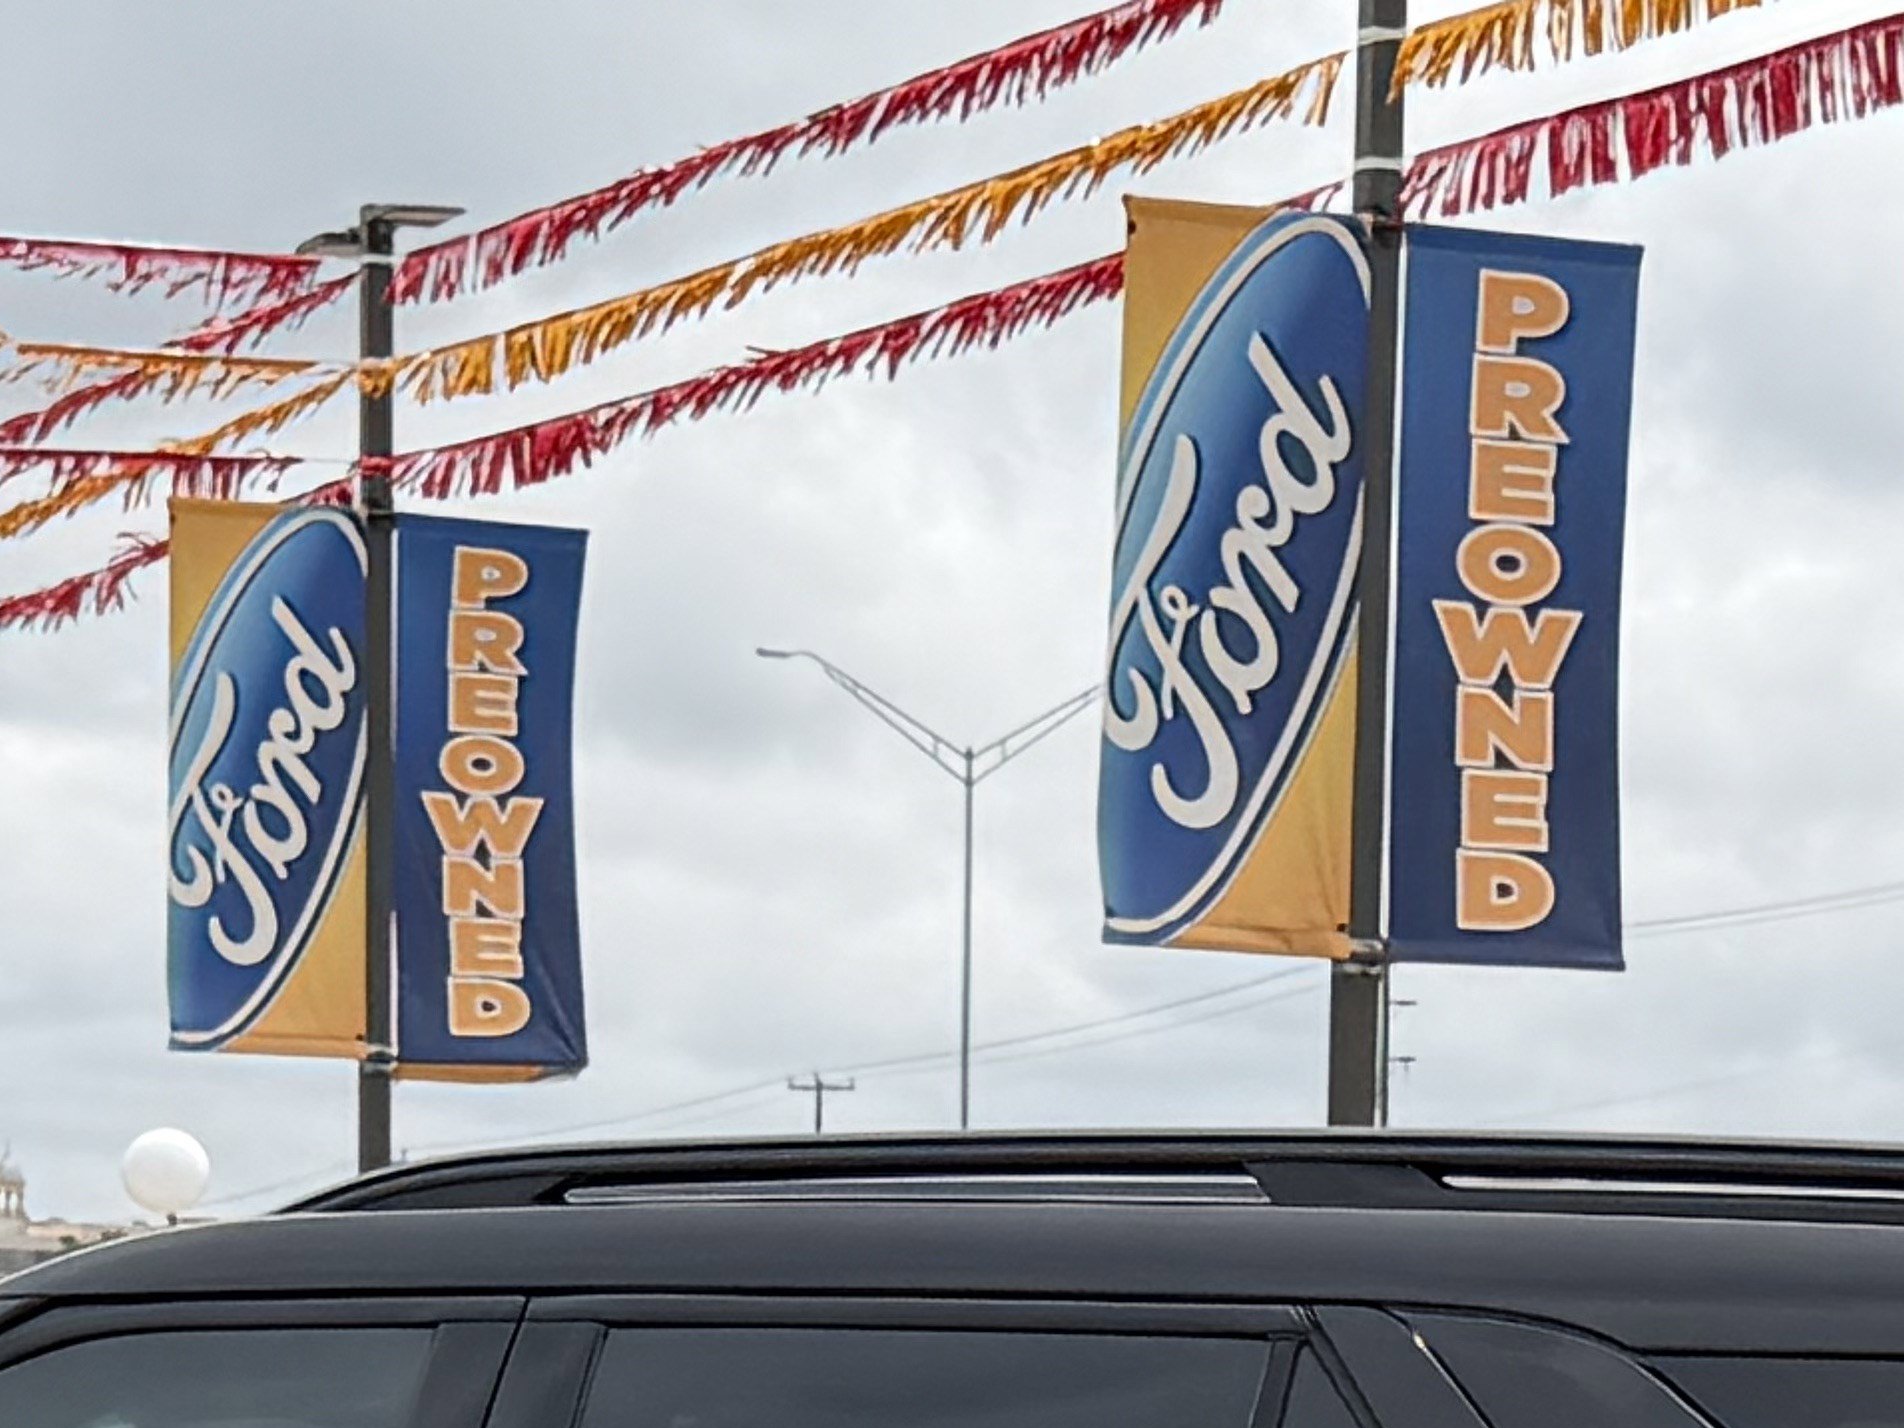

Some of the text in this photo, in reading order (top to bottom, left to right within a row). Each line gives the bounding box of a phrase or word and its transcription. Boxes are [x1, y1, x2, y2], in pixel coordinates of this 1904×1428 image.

[167, 595, 356, 966] Ford
[421, 546, 544, 1036] PREOWNED
[1104, 331, 1353, 829] Ford
[1432, 269, 1583, 932] PREOWNED
